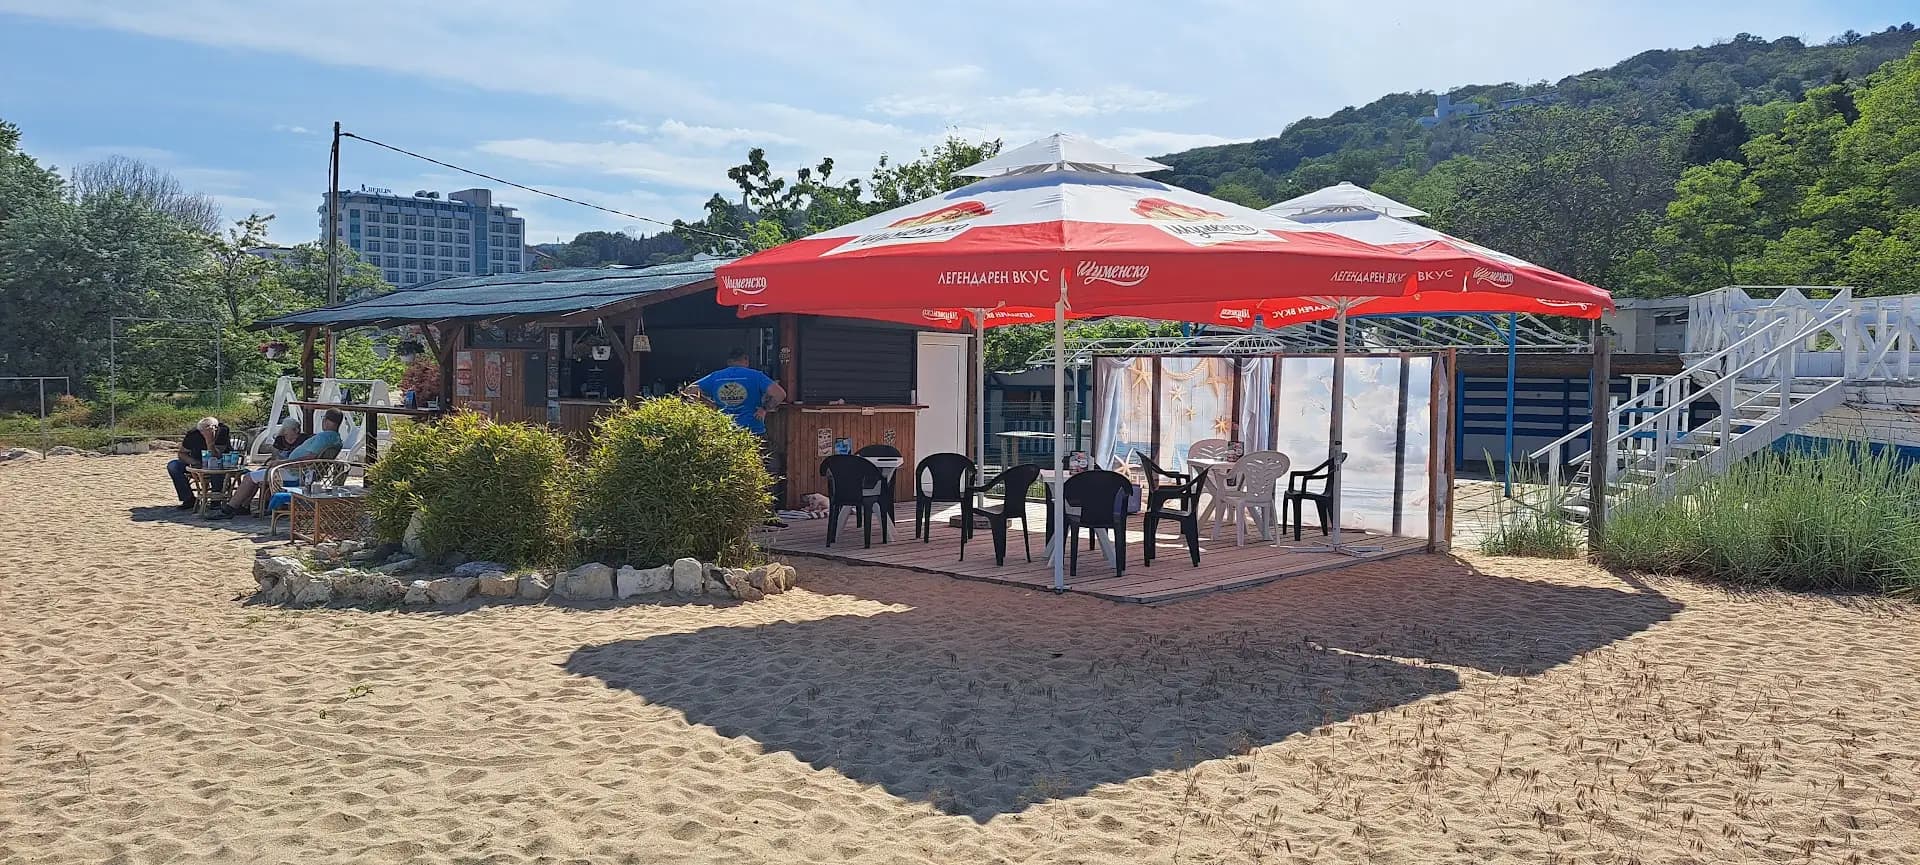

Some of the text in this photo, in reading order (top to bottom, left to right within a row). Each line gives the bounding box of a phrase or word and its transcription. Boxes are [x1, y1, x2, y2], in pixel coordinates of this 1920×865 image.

[937, 269, 1050, 286] ЛЕГЕНДАРЕН ВКУС
[1076, 260, 1150, 287] Шуменско
[1330, 270, 1385, 285] ЛЕГЕНДАРЕН
[1417, 269, 1454, 281] ВКУС
